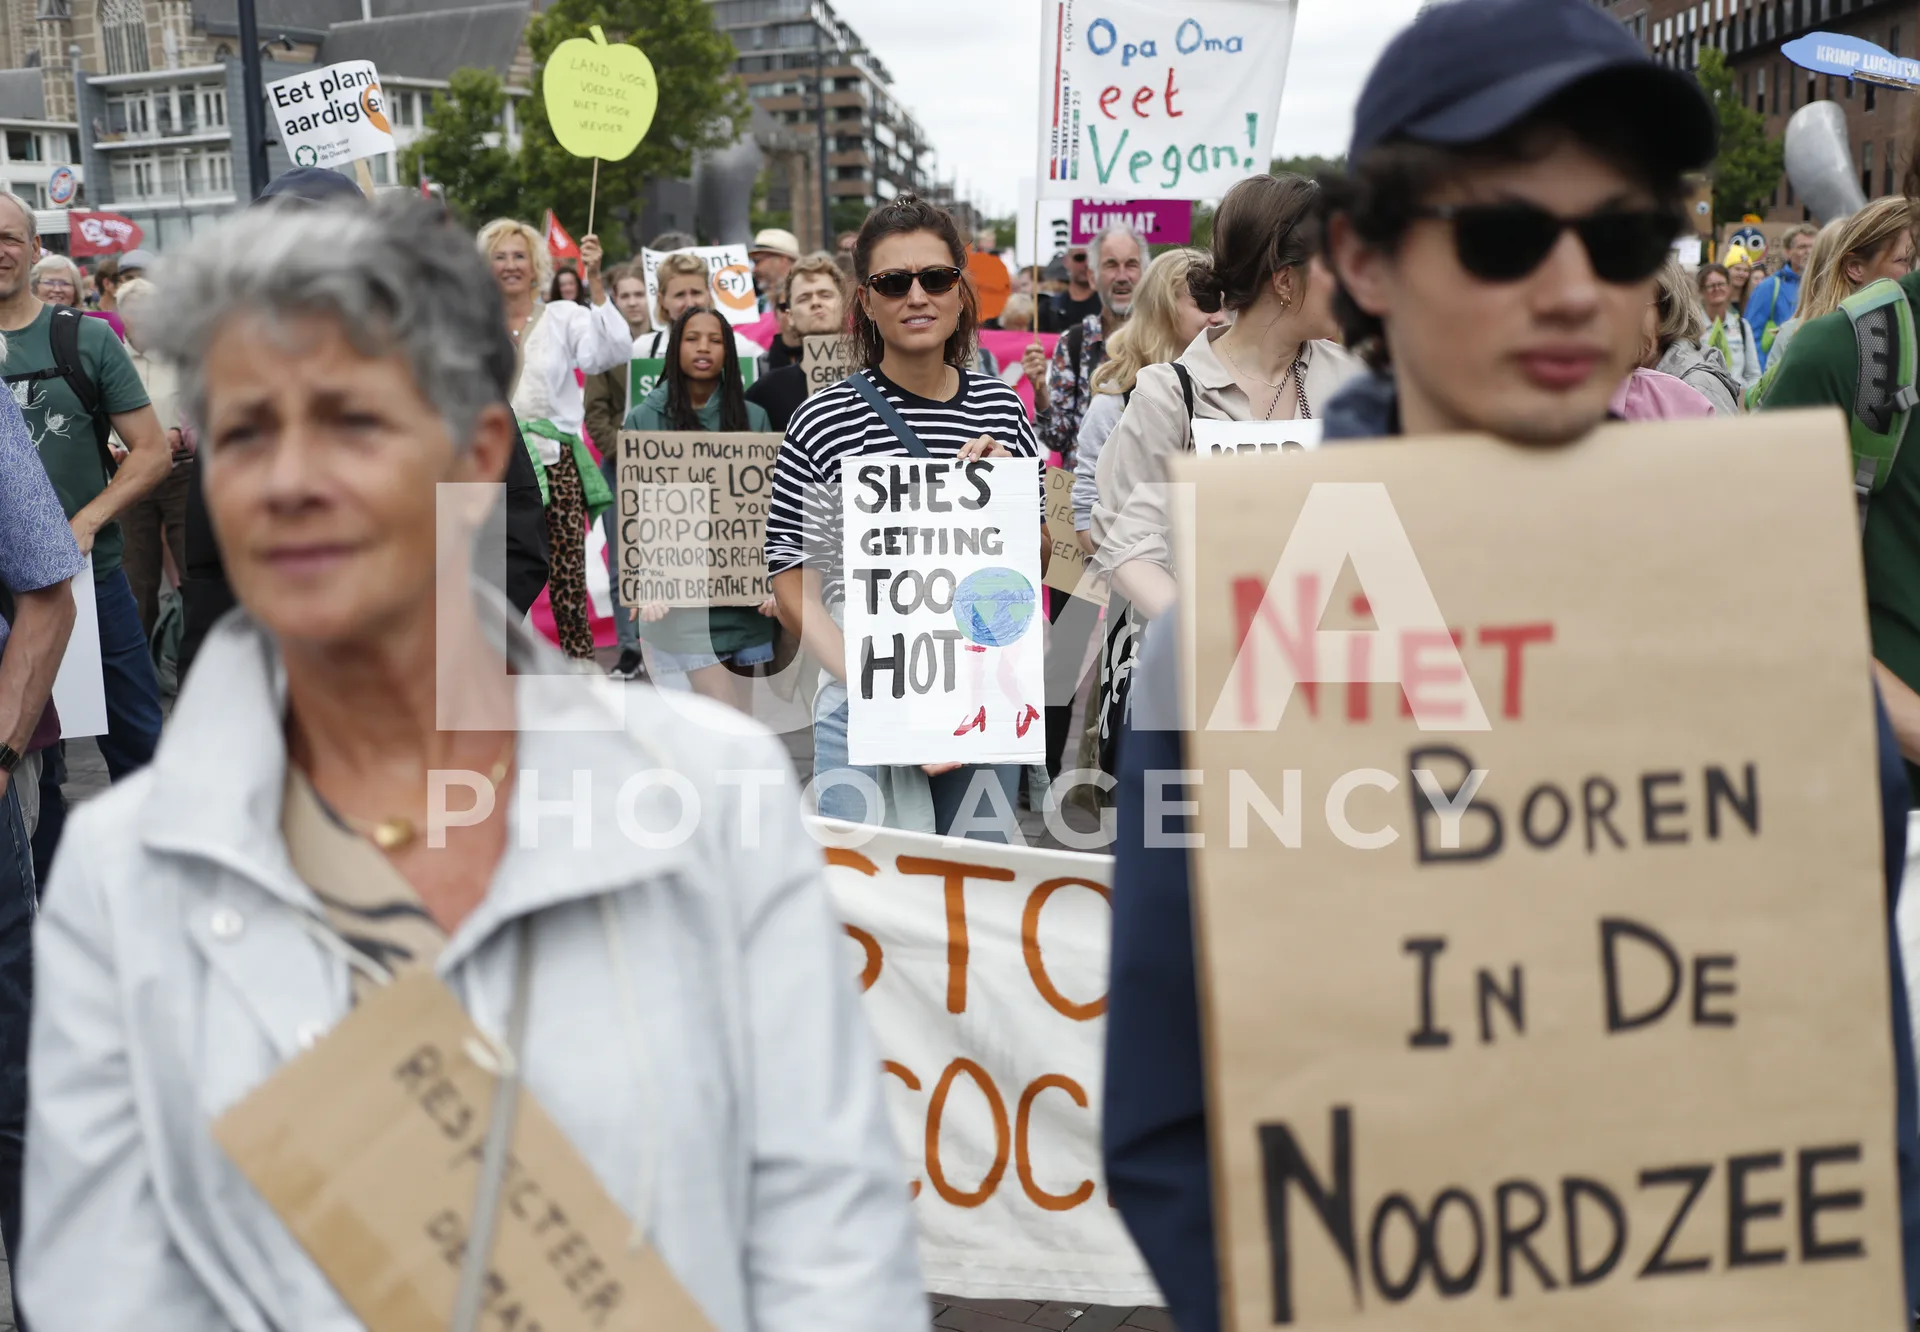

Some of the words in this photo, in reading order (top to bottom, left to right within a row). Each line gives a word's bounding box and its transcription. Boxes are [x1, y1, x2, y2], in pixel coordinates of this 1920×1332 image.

[1087, 17, 1157, 67] Opa
[1175, 17, 1243, 55] Oma
[1816, 44, 1860, 67] KRIMP
[570, 57, 611, 77] LAND
[619, 72, 648, 89] VOOR
[273, 81, 314, 108] Eet
[580, 81, 628, 100] VOEDSEL
[1099, 67, 1184, 120] eet
[573, 99, 598, 112] NIET
[605, 103, 630, 118] VOOR
[1086, 112, 1258, 190] Vegan!
[625, 438, 684, 460] HOW
[692, 441, 743, 460] MUCH
[748, 444, 781, 461] MO
[621, 464, 679, 484] MUST
[688, 466, 717, 485] WE
[728, 463, 774, 498] LOS
[854, 459, 995, 513] SHE'S
[621, 487, 721, 516] BEFORE
[735, 501, 770, 515] YOU
[621, 518, 763, 545] CORPORAT
[860, 526, 1004, 556] GETTING
[624, 546, 728, 569] OVERLORDS
[731, 546, 768, 568] REAL
[1051, 539, 1086, 567] EEM
[623, 569, 646, 577] THAT
[648, 569, 665, 577] YOU
[621, 577, 682, 602] CANNOT
[685, 575, 749, 599] BREATHE
[752, 576, 774, 596] MO
[852, 568, 957, 615] TOO
[860, 629, 963, 699] HOT
[1256, 1103, 1868, 1326] NOORDZEE
